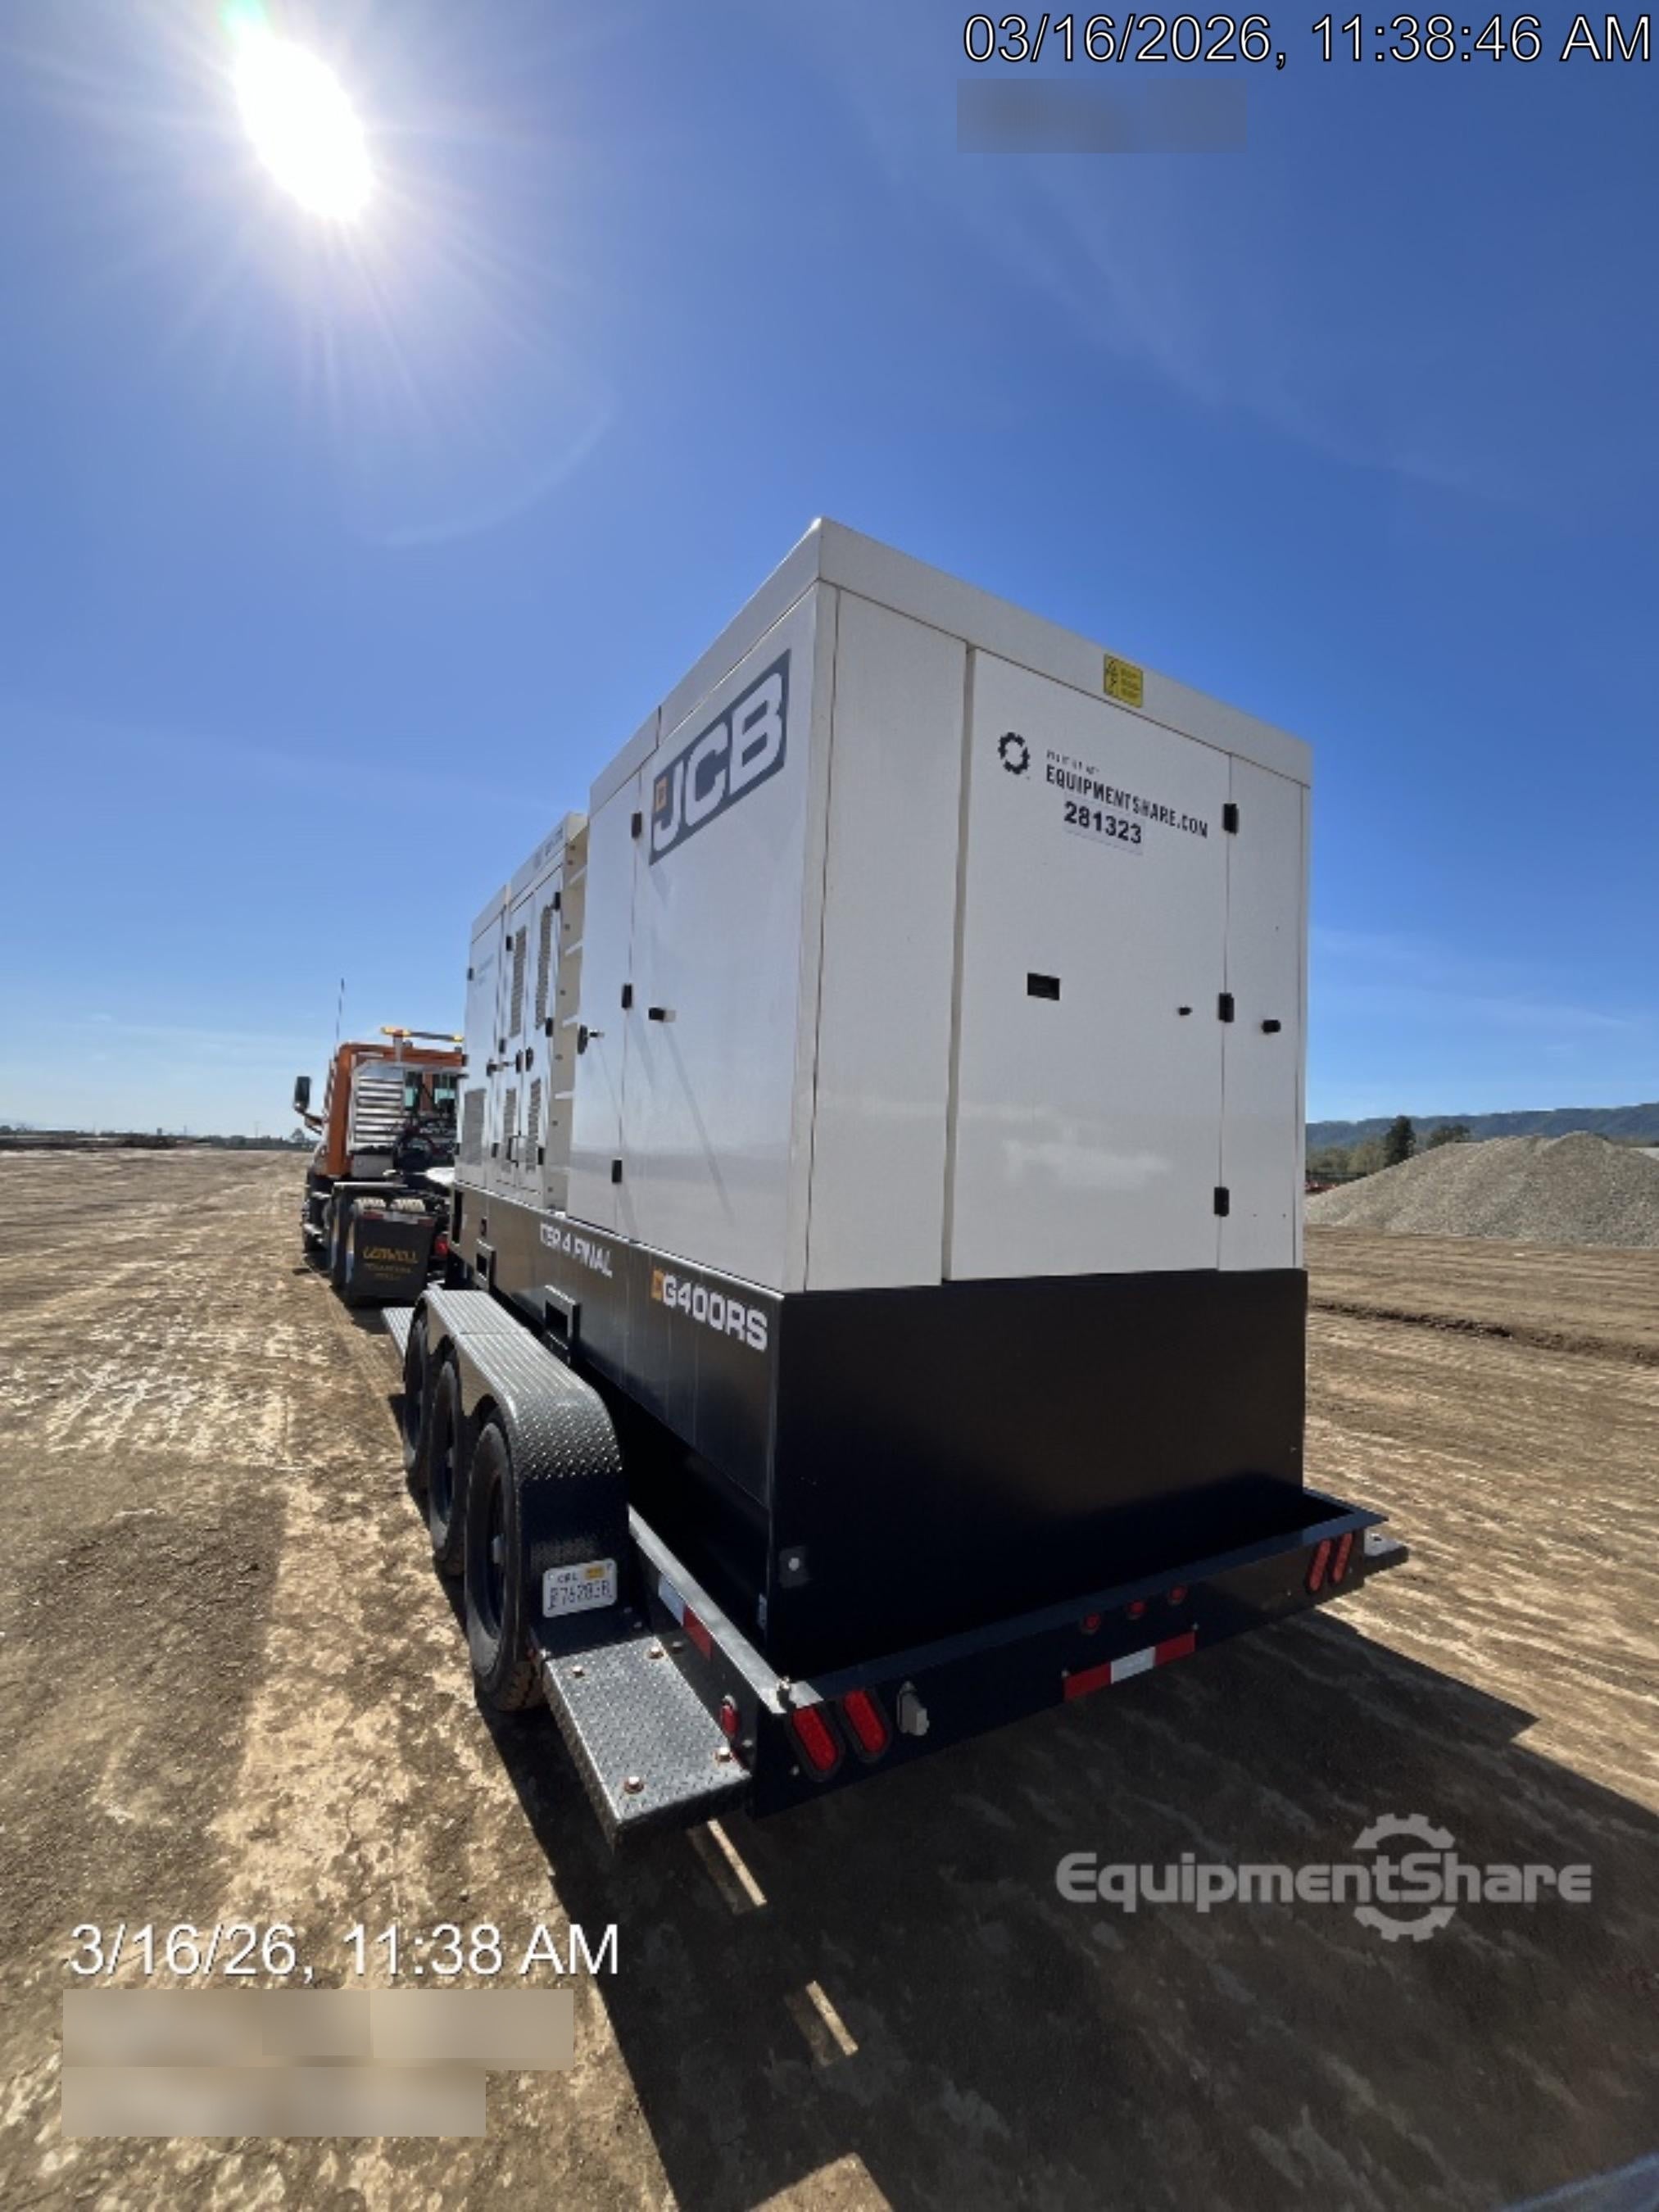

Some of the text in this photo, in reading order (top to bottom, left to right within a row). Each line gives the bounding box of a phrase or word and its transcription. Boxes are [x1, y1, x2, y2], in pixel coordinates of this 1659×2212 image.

[652, 672, 783, 853] JCB
[1046, 764, 1208, 839] EQUIPMENTSHARE.COM
[1064, 800, 1142, 845] 281323
[662, 1273, 768, 1352] G400RS
